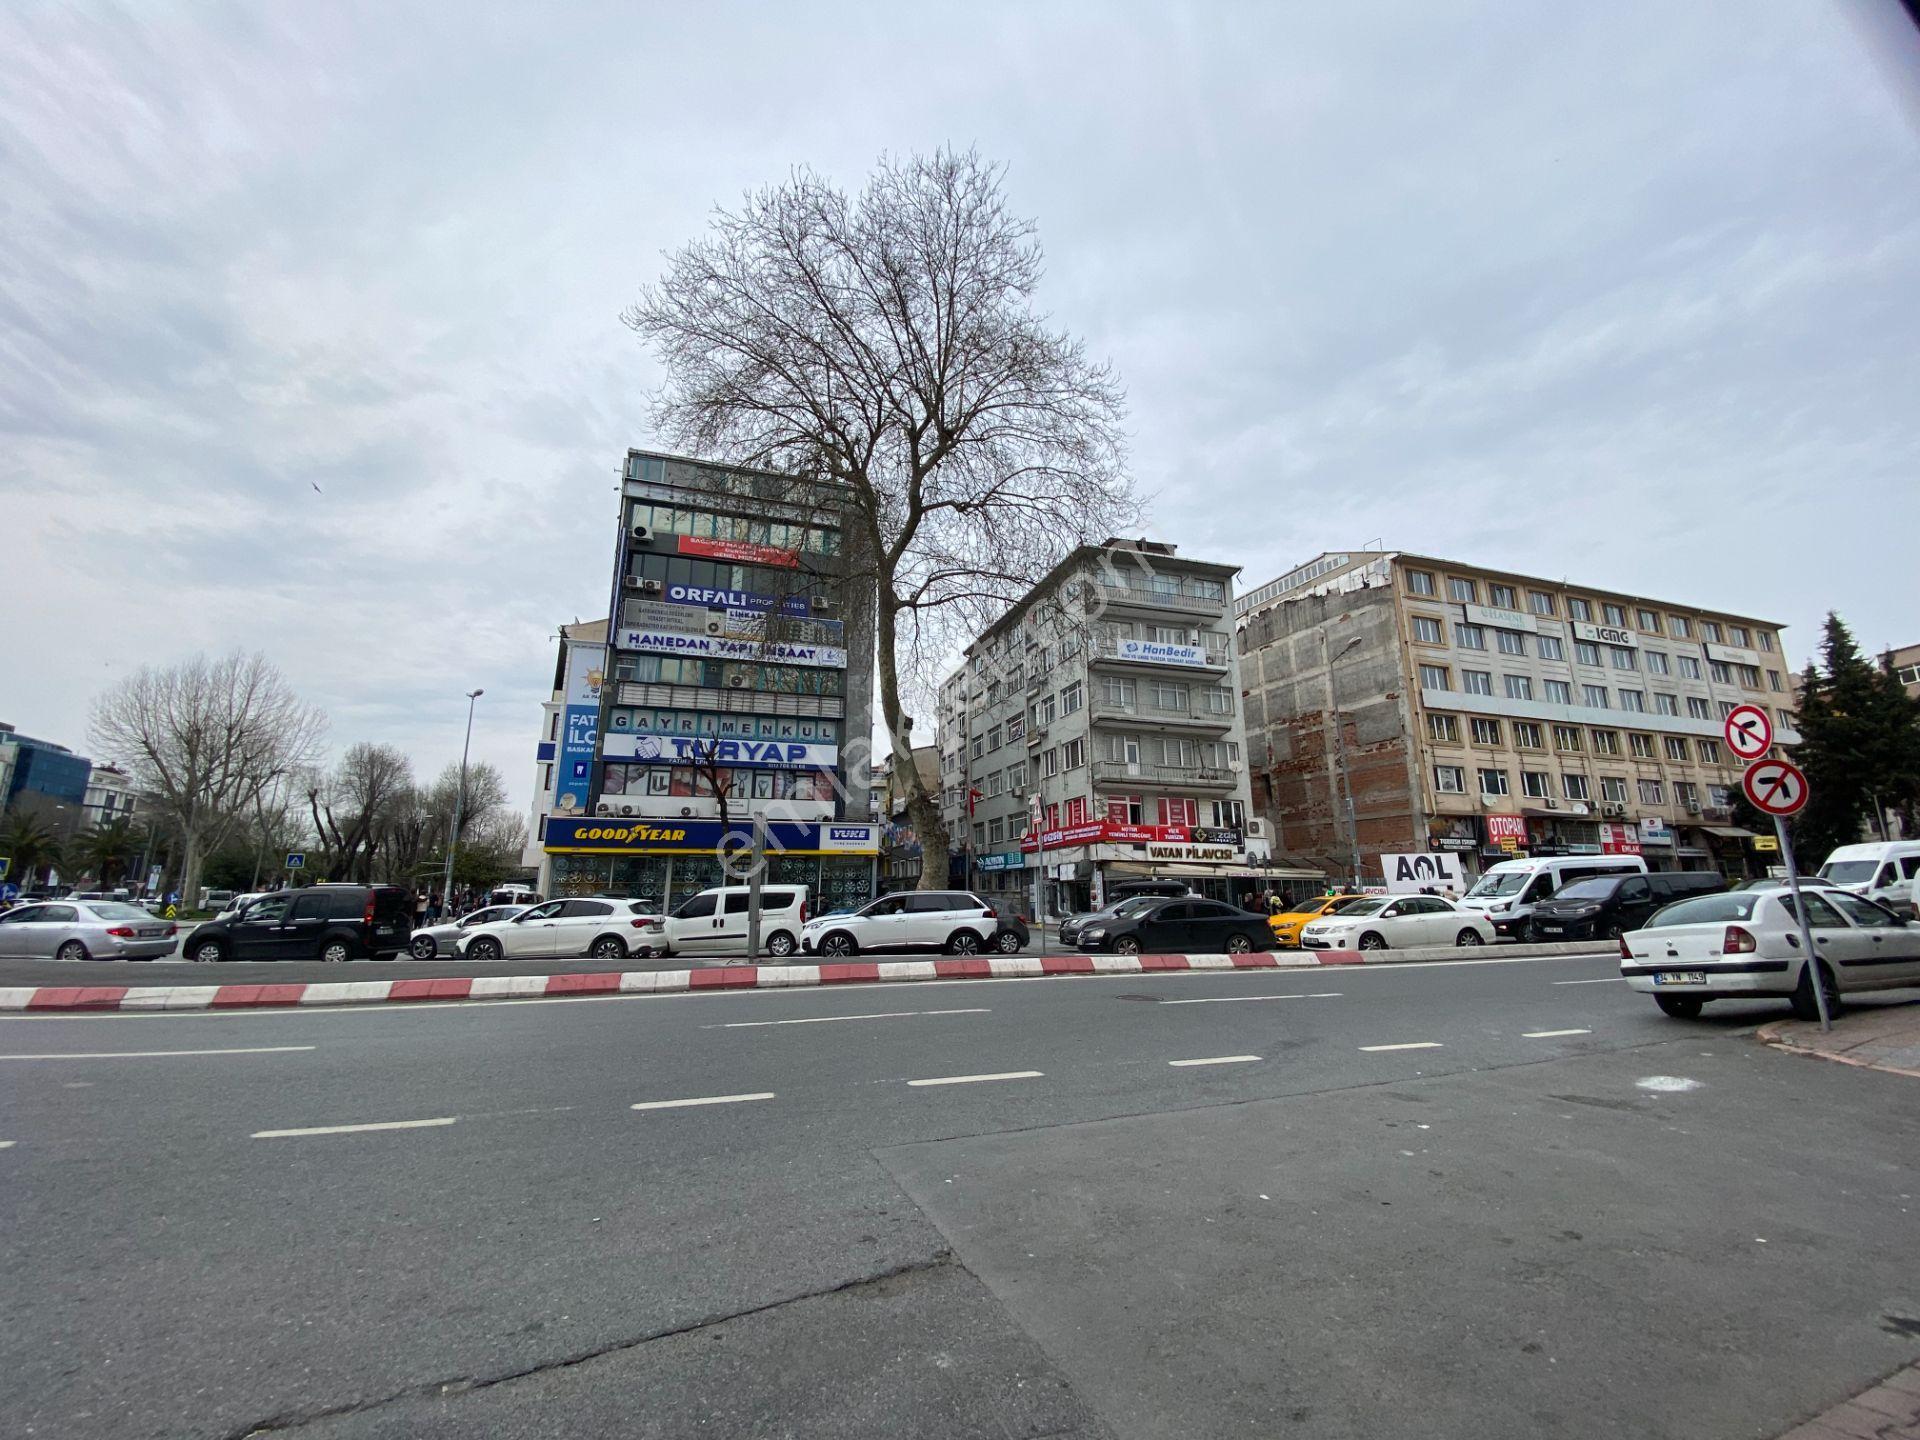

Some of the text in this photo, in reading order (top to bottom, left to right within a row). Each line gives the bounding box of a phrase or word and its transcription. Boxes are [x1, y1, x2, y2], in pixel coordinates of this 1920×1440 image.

[628, 633, 710, 650] HANEDAN
[718, 641, 753, 653] YAPI
[1142, 644, 1197, 658] HanBedir
[615, 716, 831, 738] GAYRİMENKUL
[671, 738, 807, 762] TURYAP
[574, 826, 687, 842] GOODYEAR
[1489, 817, 1525, 836] OTOPARK
[1150, 845, 1233, 860] VATAN PİLAVCISI
[1621, 845, 1641, 853] EMLAK
